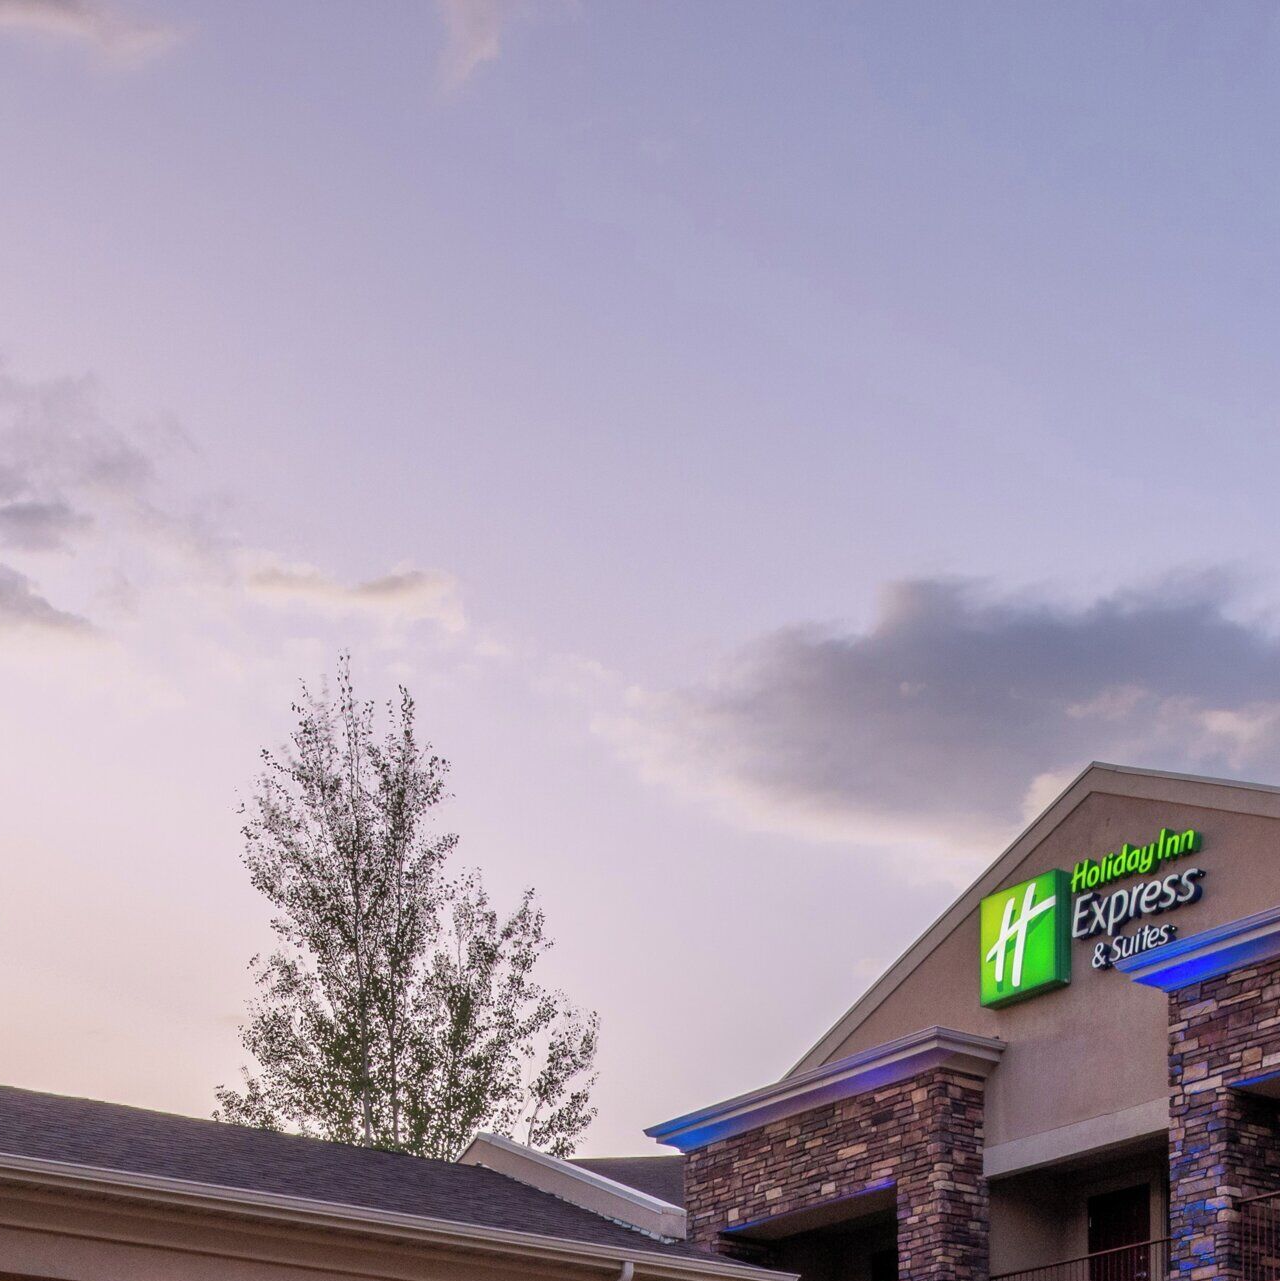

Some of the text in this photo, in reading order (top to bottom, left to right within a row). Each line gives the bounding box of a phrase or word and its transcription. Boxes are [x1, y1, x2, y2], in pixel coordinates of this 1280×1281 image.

[1070, 827, 1196, 894] Holiday Inn
[1071, 867, 1200, 939] Express
[1091, 923, 1170, 969] & Suites
